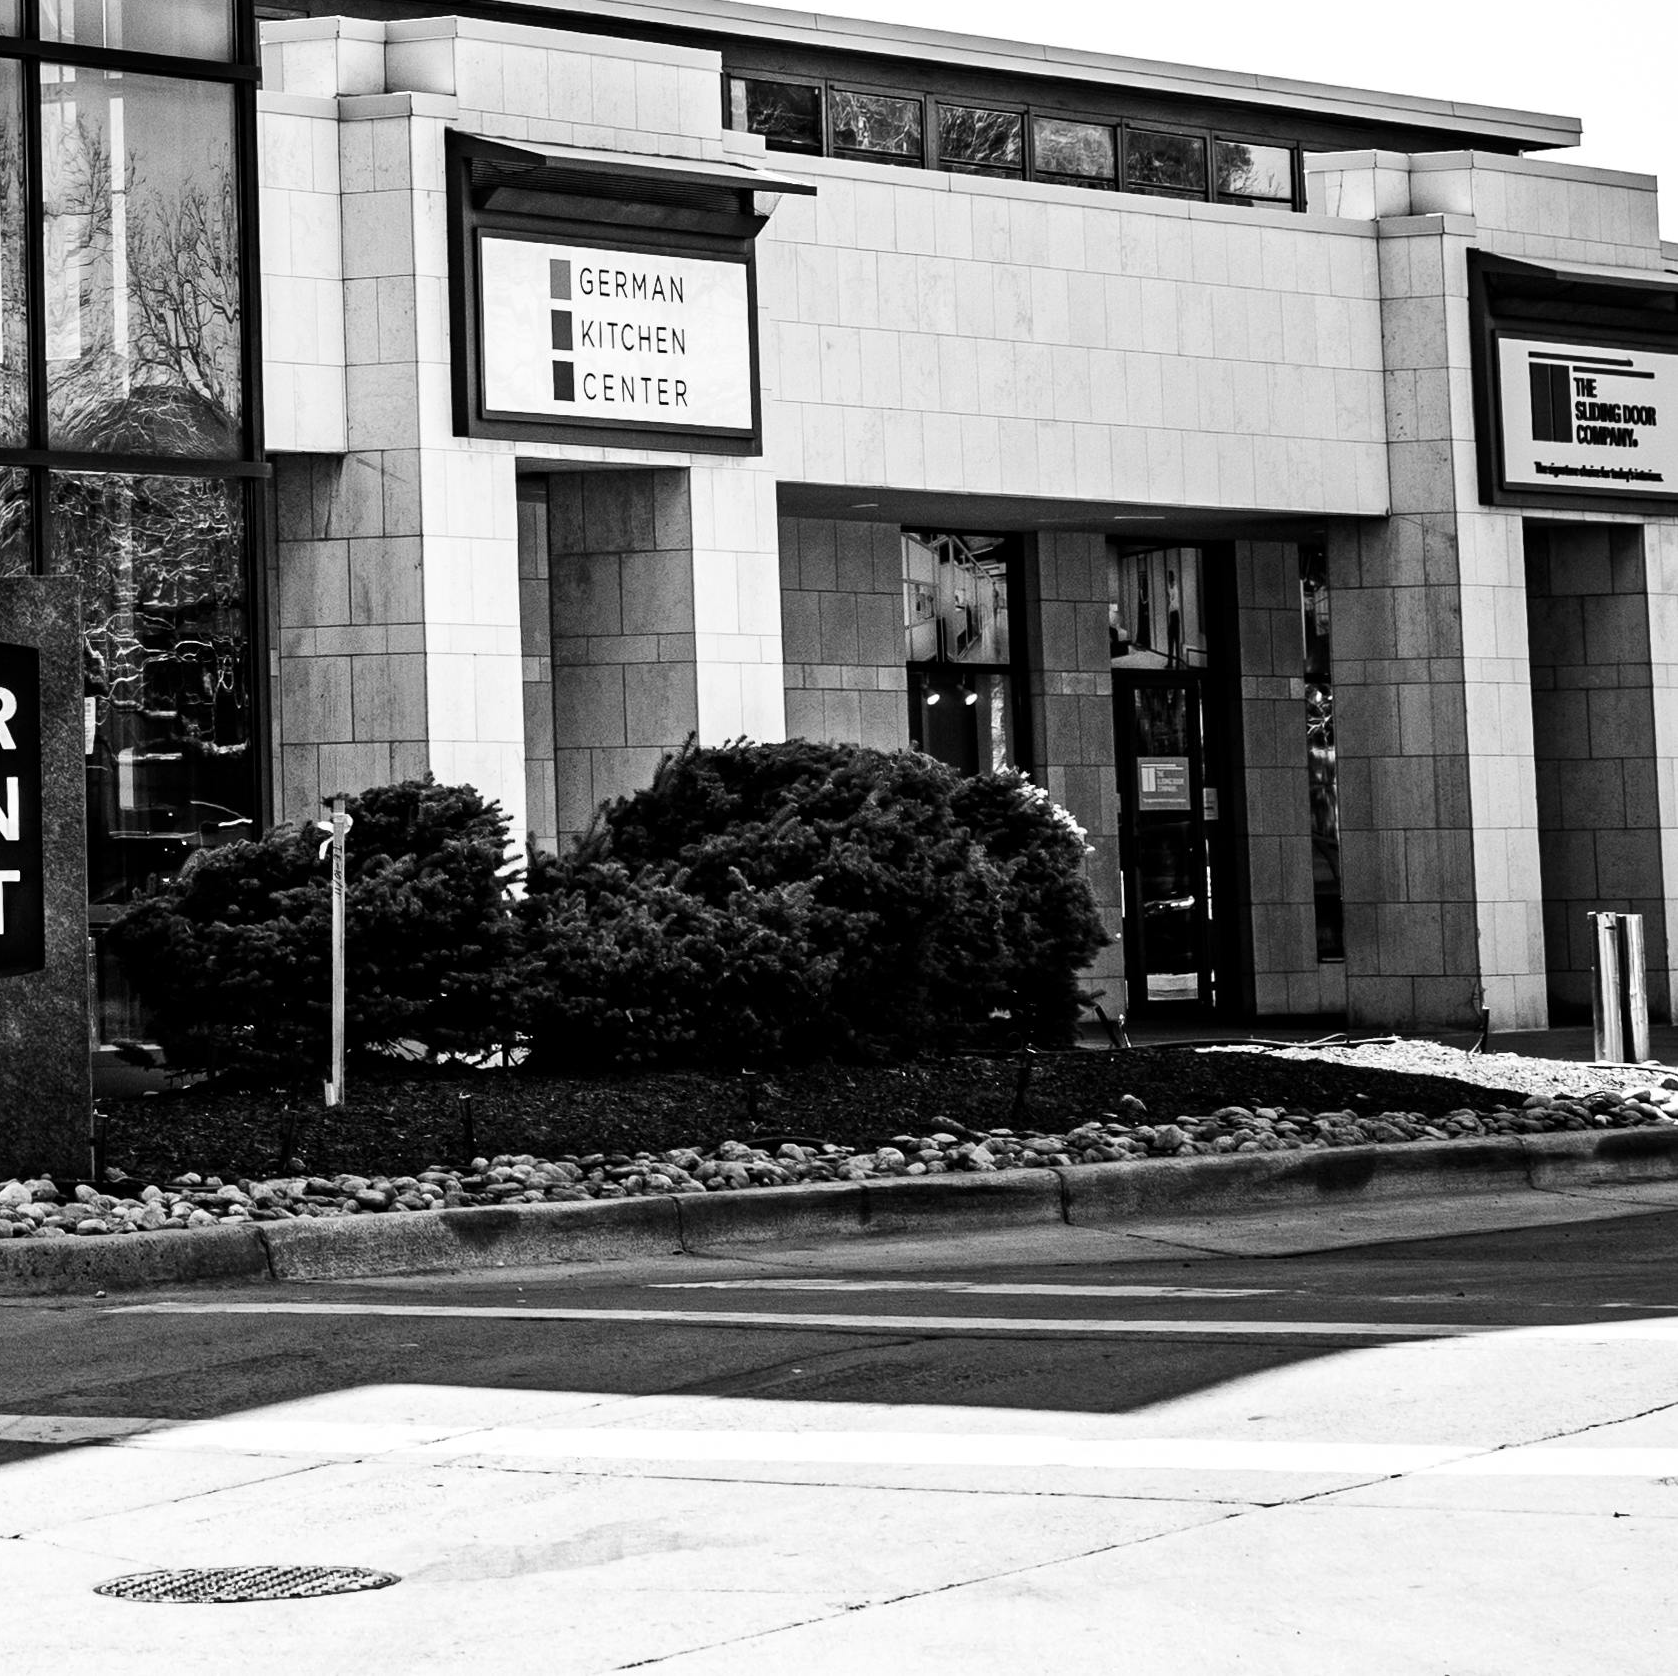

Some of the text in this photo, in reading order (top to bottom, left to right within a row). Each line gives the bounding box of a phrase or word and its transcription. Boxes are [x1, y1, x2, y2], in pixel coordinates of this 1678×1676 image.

[579, 267, 684, 304] GERMAN
[581, 320, 686, 355] KITCHEN
[583, 372, 688, 407] CENTER
[1573, 377, 1598, 398] THE
[1575, 401, 1657, 427] SLIDING DOOR
